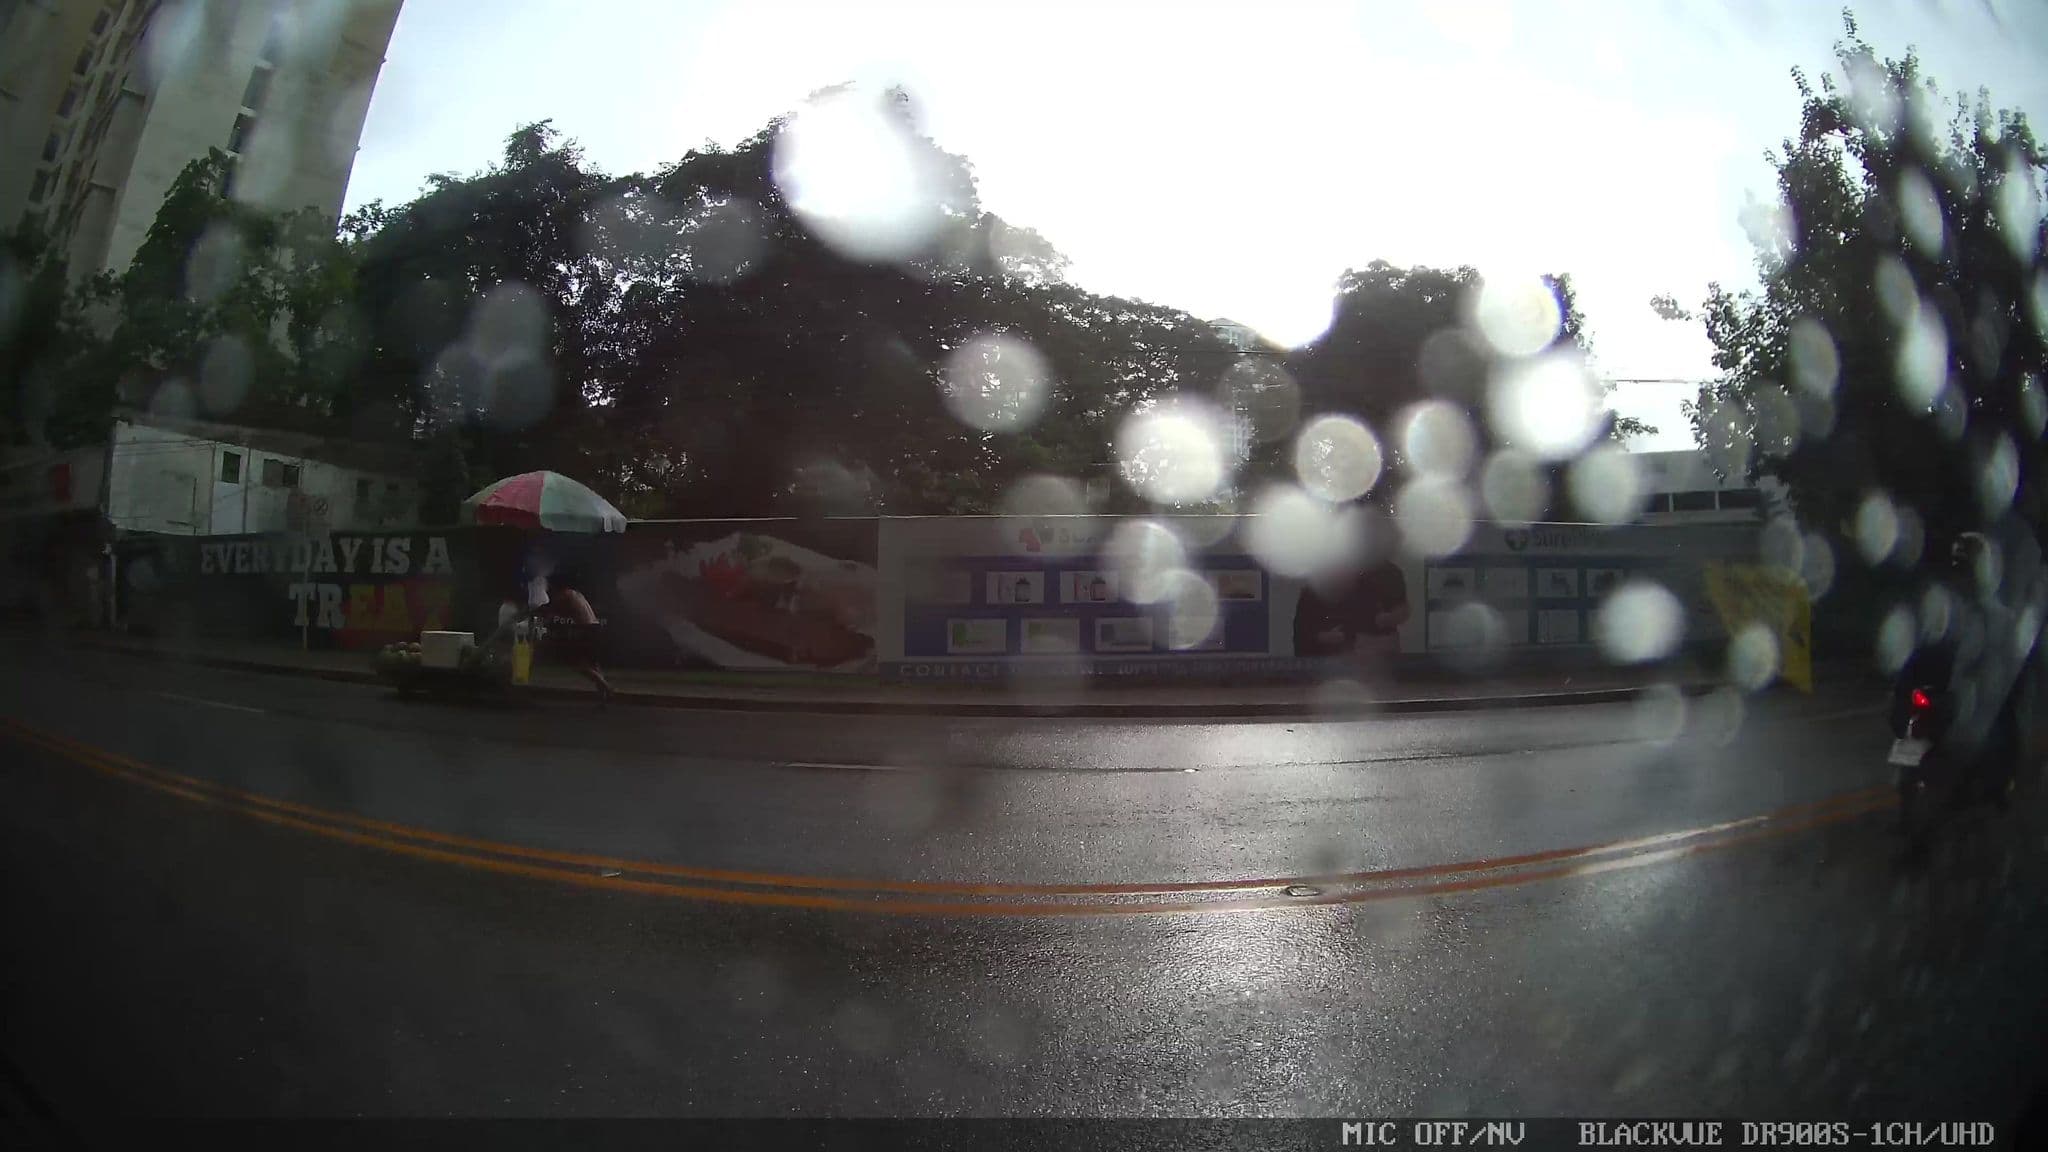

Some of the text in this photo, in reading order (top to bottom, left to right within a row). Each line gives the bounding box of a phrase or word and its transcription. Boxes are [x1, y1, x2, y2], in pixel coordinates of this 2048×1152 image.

[200, 536, 453, 575] EVERYDAY IS A
[288, 583, 452, 630] TREAT
